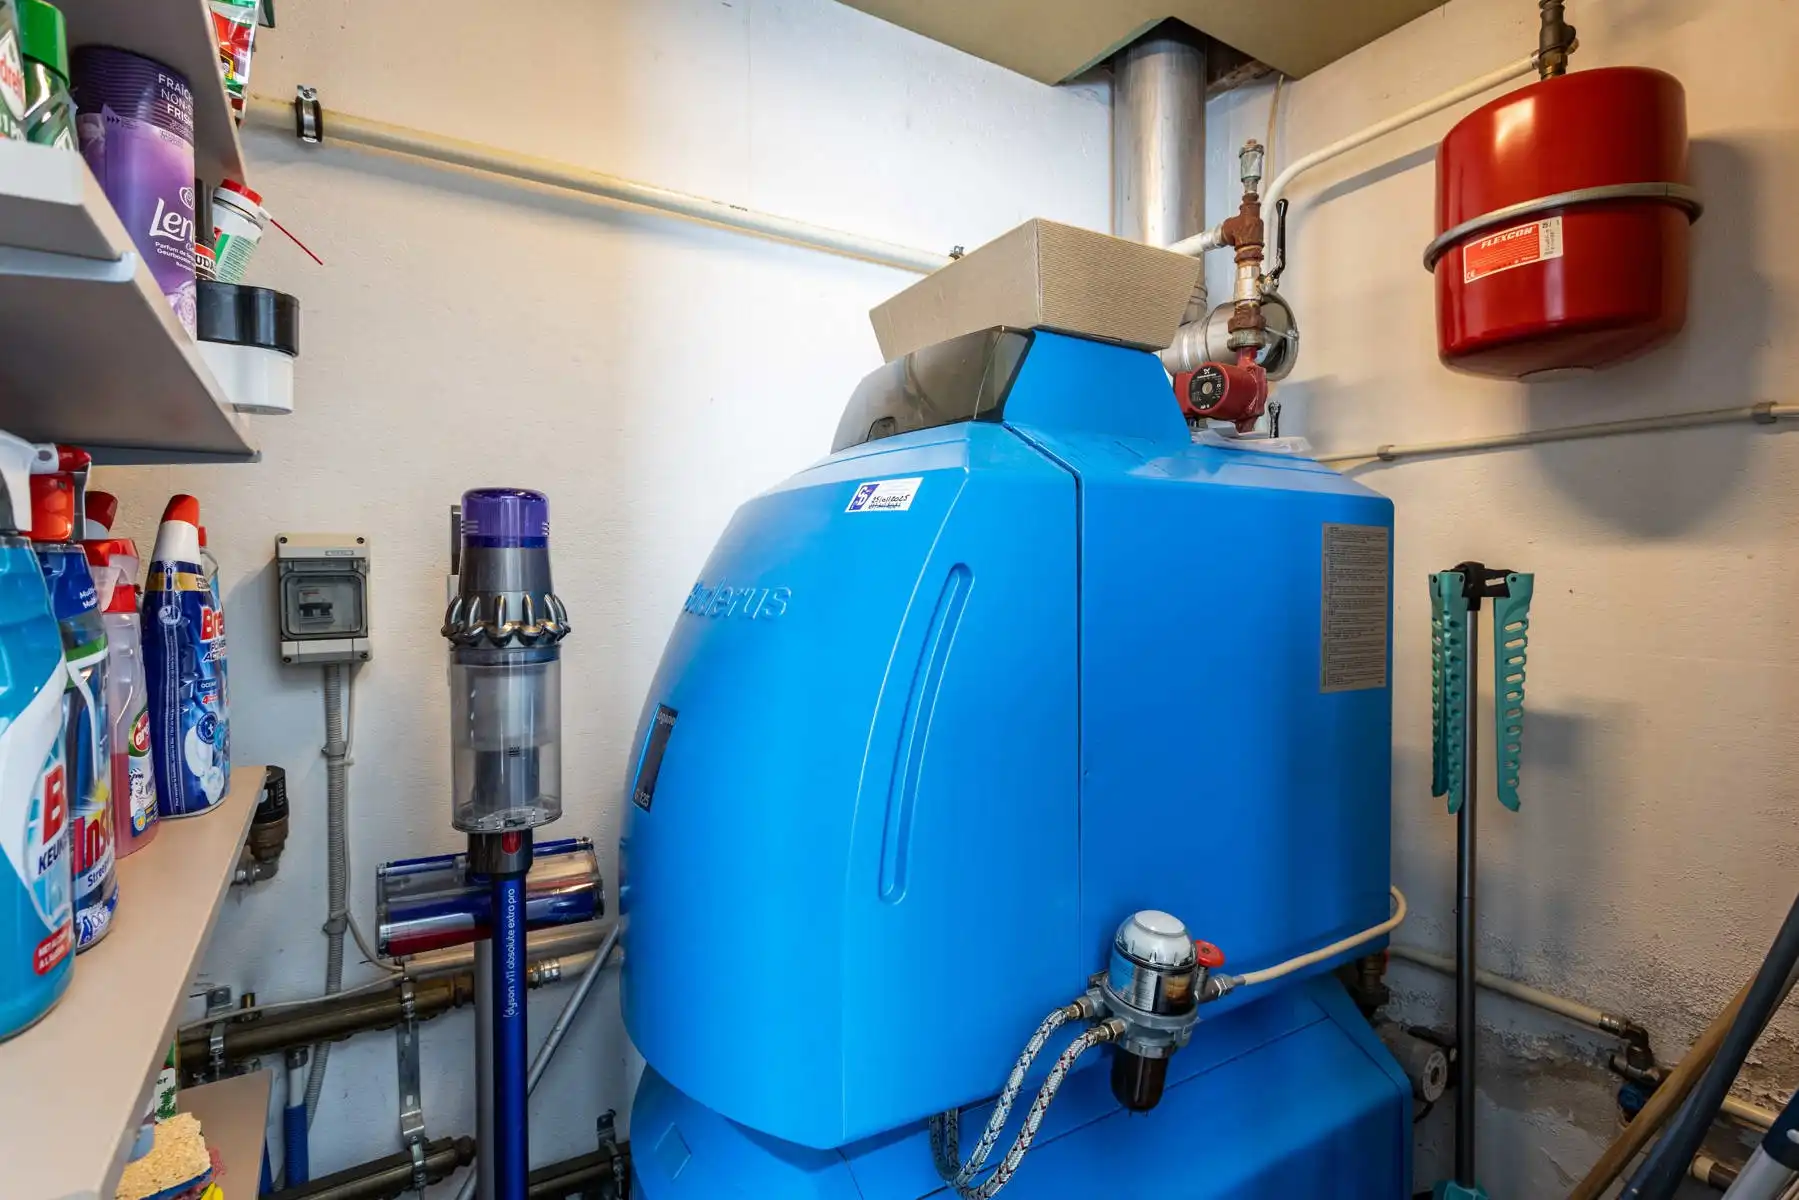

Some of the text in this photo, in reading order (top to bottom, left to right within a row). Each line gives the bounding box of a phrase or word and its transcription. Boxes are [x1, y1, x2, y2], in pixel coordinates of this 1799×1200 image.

[1481, 226, 1533, 249] FLEXCON
[507, 888, 517, 905] pro
[505, 905, 516, 929] extra
[505, 929, 516, 970] absolute
